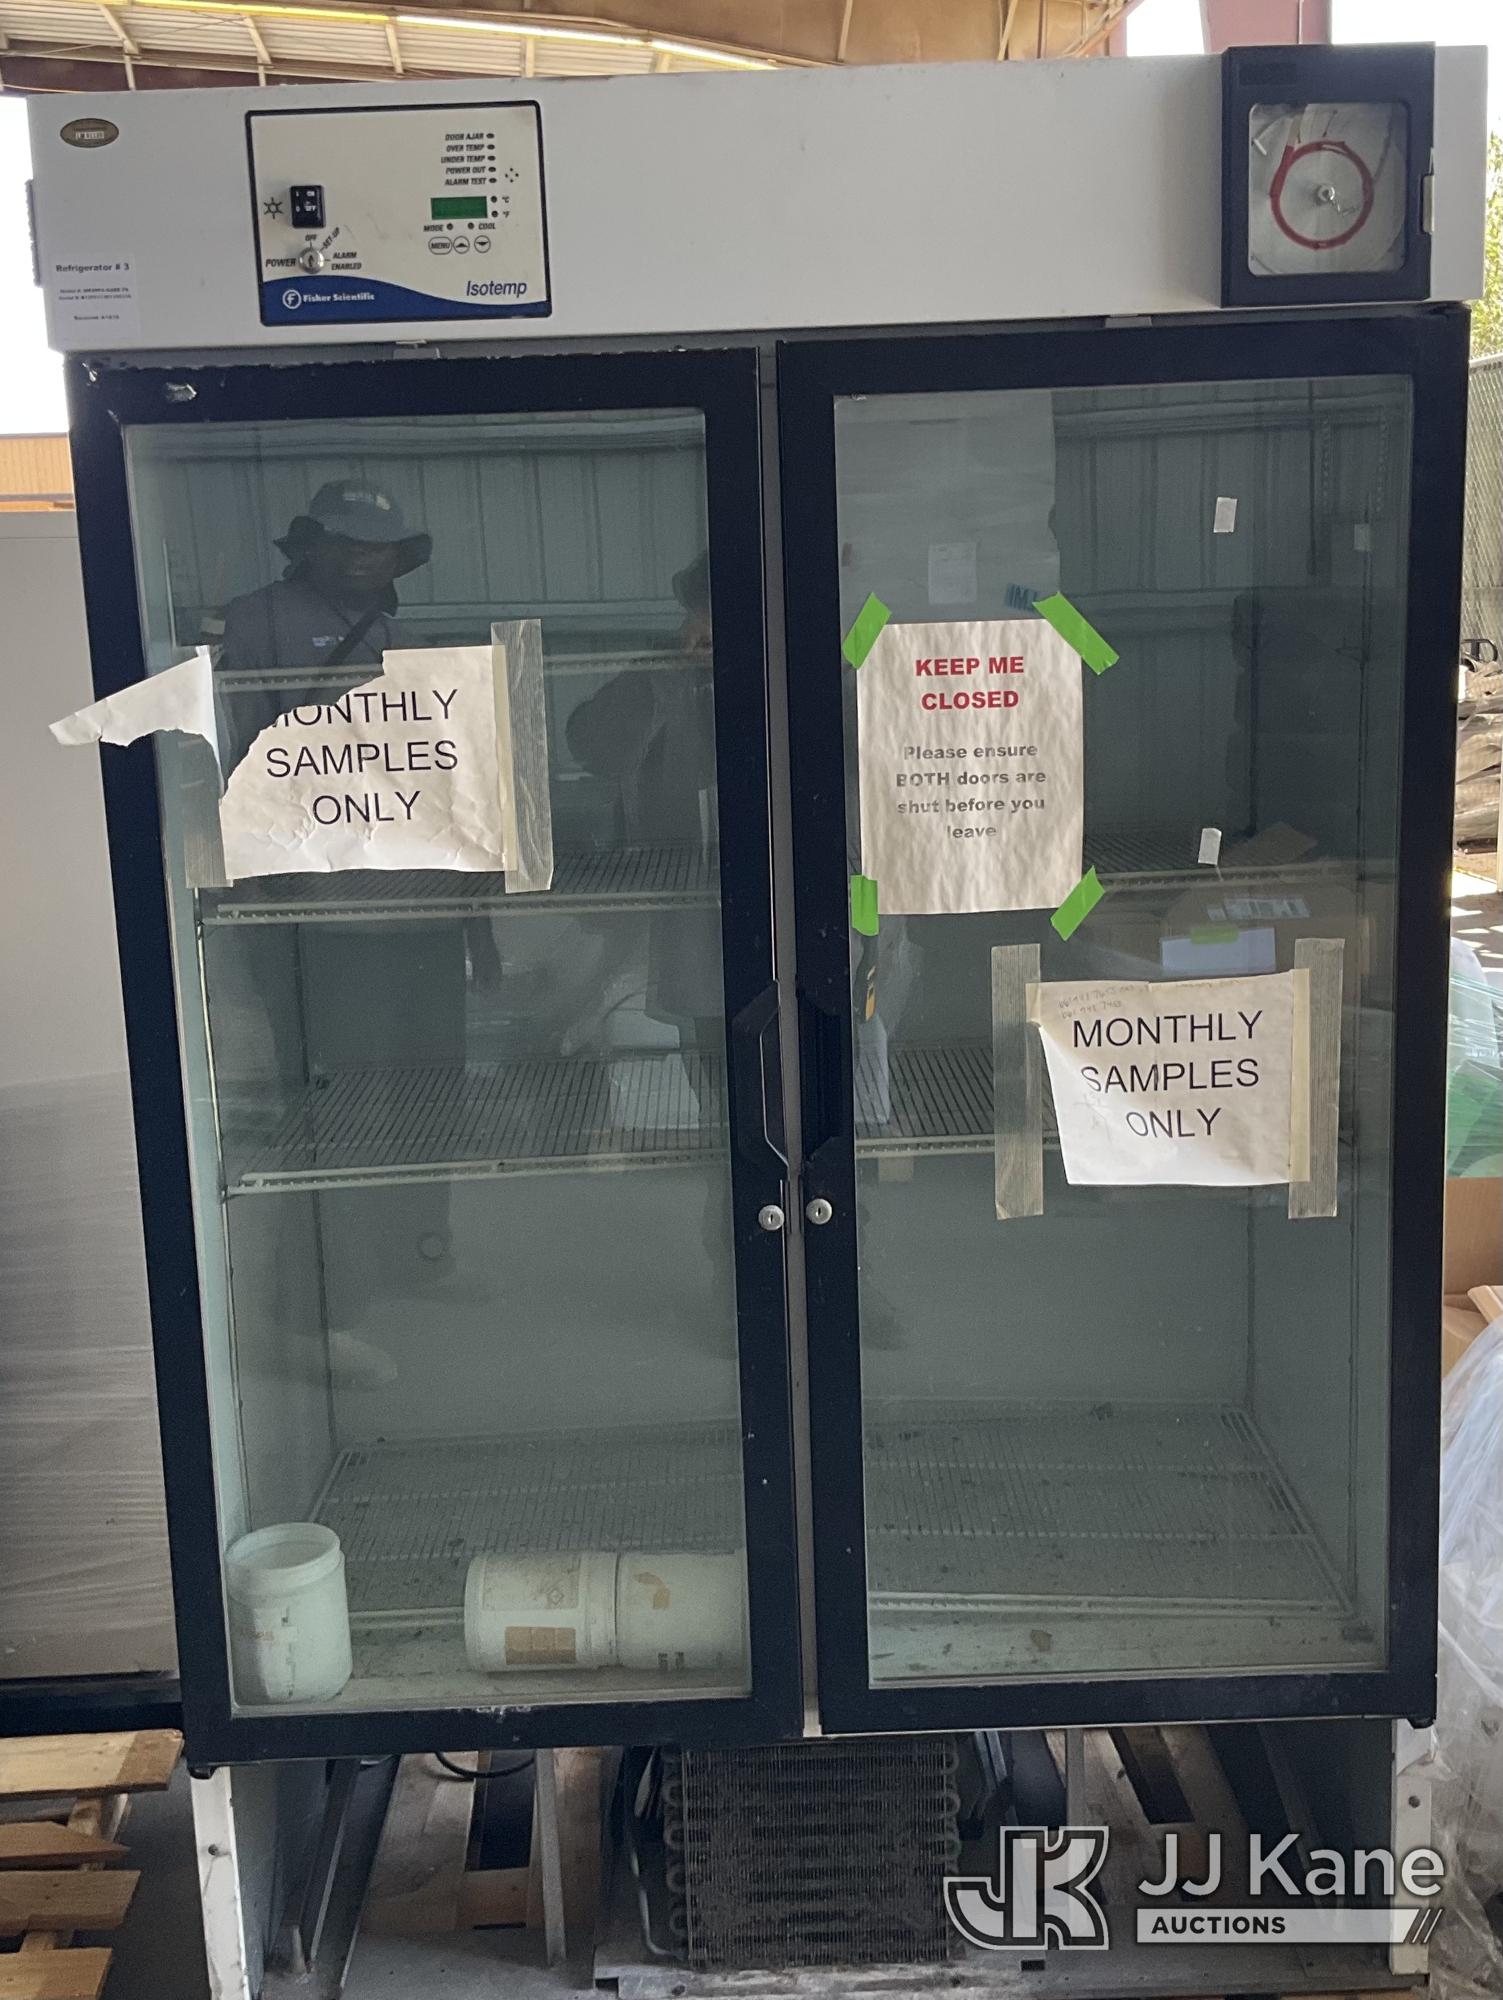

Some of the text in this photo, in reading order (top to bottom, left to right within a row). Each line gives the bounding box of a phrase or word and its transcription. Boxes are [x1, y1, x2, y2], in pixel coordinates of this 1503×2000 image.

[423, 224, 444, 232] MODE
[265, 258, 296, 267] POWER
[333, 251, 357, 259] ALARM
[56, 264, 112, 273] Refrigerator
[123, 262, 130, 270] 3
[331, 263, 362, 271] ENABLED
[303, 293, 331, 302] Fisher
[333, 292, 375, 302] Scientific
[466, 280, 527, 299] Isotemp
[915, 656, 1025, 676] KEEP ME
[921, 690, 1019, 710] CLOSED
[266, 740, 458, 778] SAMPLES
[904, 745, 1038, 760] Please ensure
[896, 771, 1047, 787] BOTH doors are
[313, 791, 421, 825] ONLY
[897, 798, 1045, 814] shut before you
[947, 825, 997, 839] leave
[1073, 1010, 1263, 1048] MONTHLY
[1080, 1058, 1259, 1093] SAMPLES
[1126, 1107, 1222, 1139] ONLY
